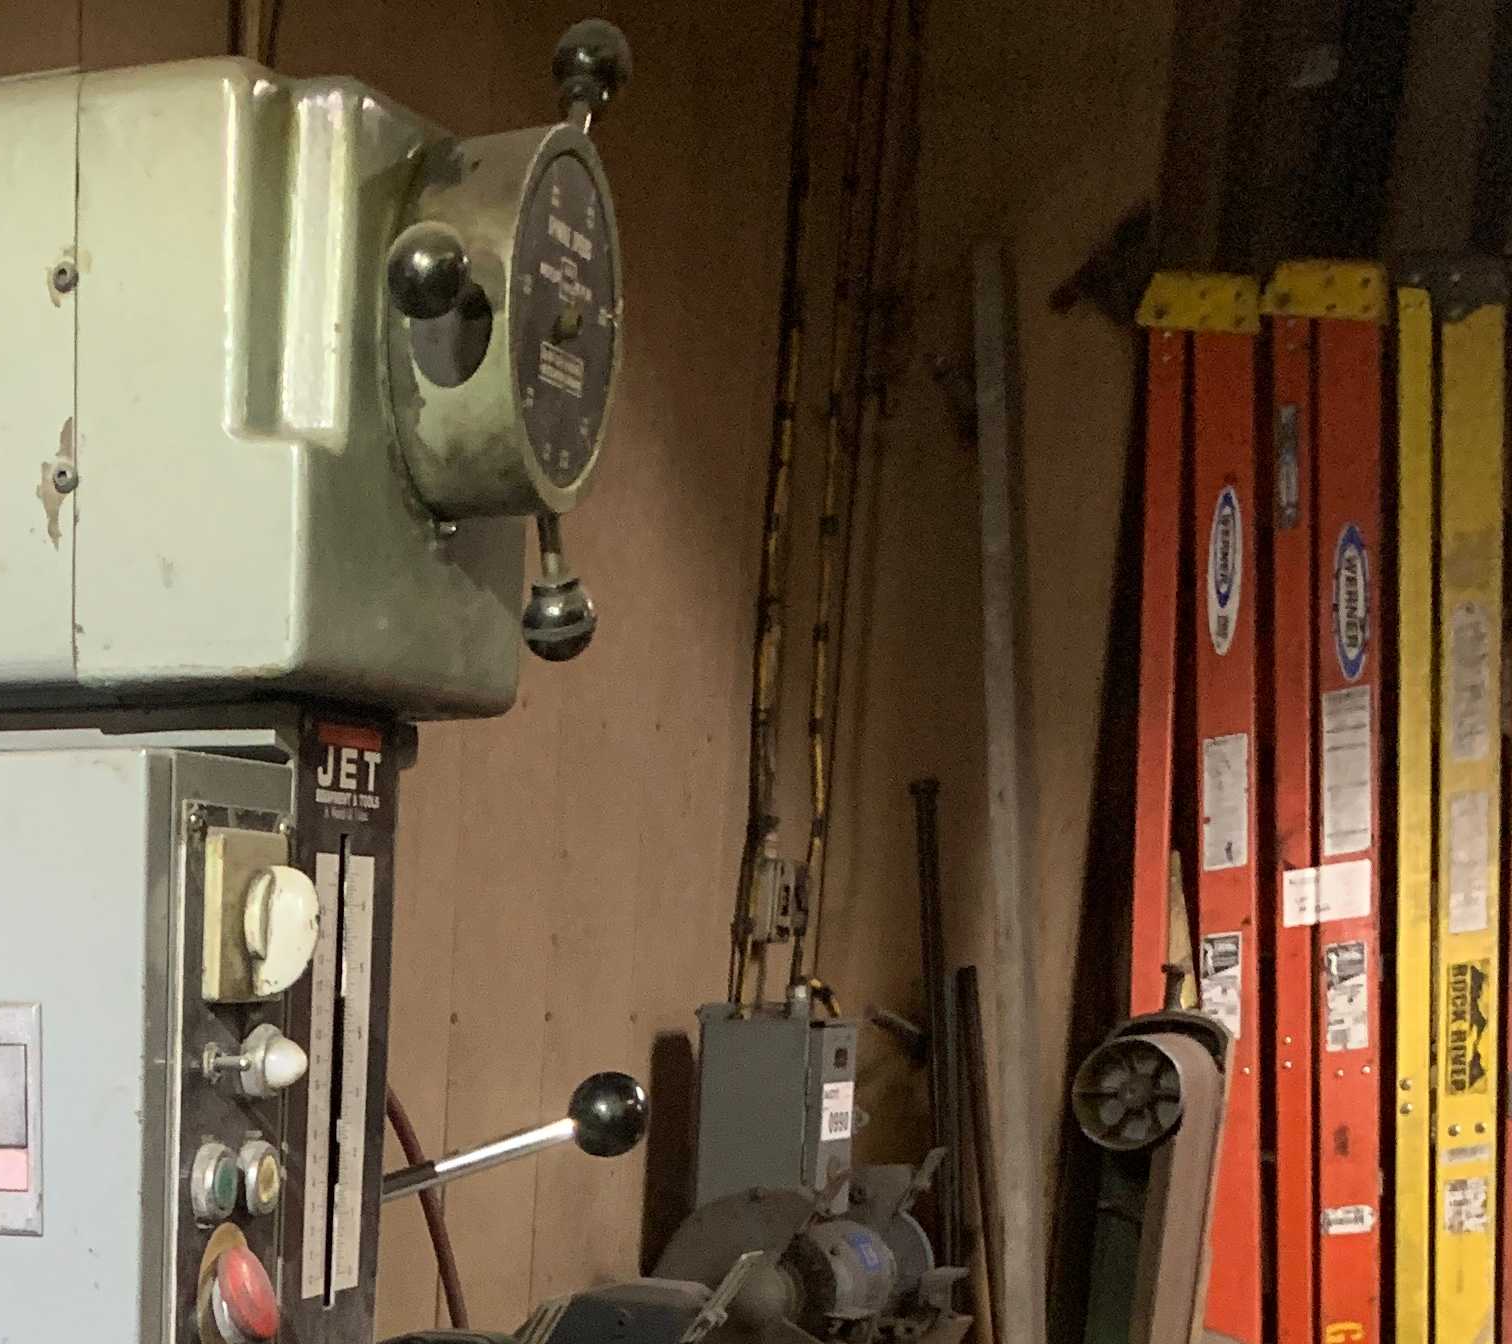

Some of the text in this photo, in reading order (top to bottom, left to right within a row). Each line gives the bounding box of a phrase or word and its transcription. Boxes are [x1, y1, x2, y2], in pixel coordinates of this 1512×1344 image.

[1344, 556, 1360, 648] WERNER
[317, 745, 381, 792] JET
[1451, 964, 1468, 1022] ROCK
